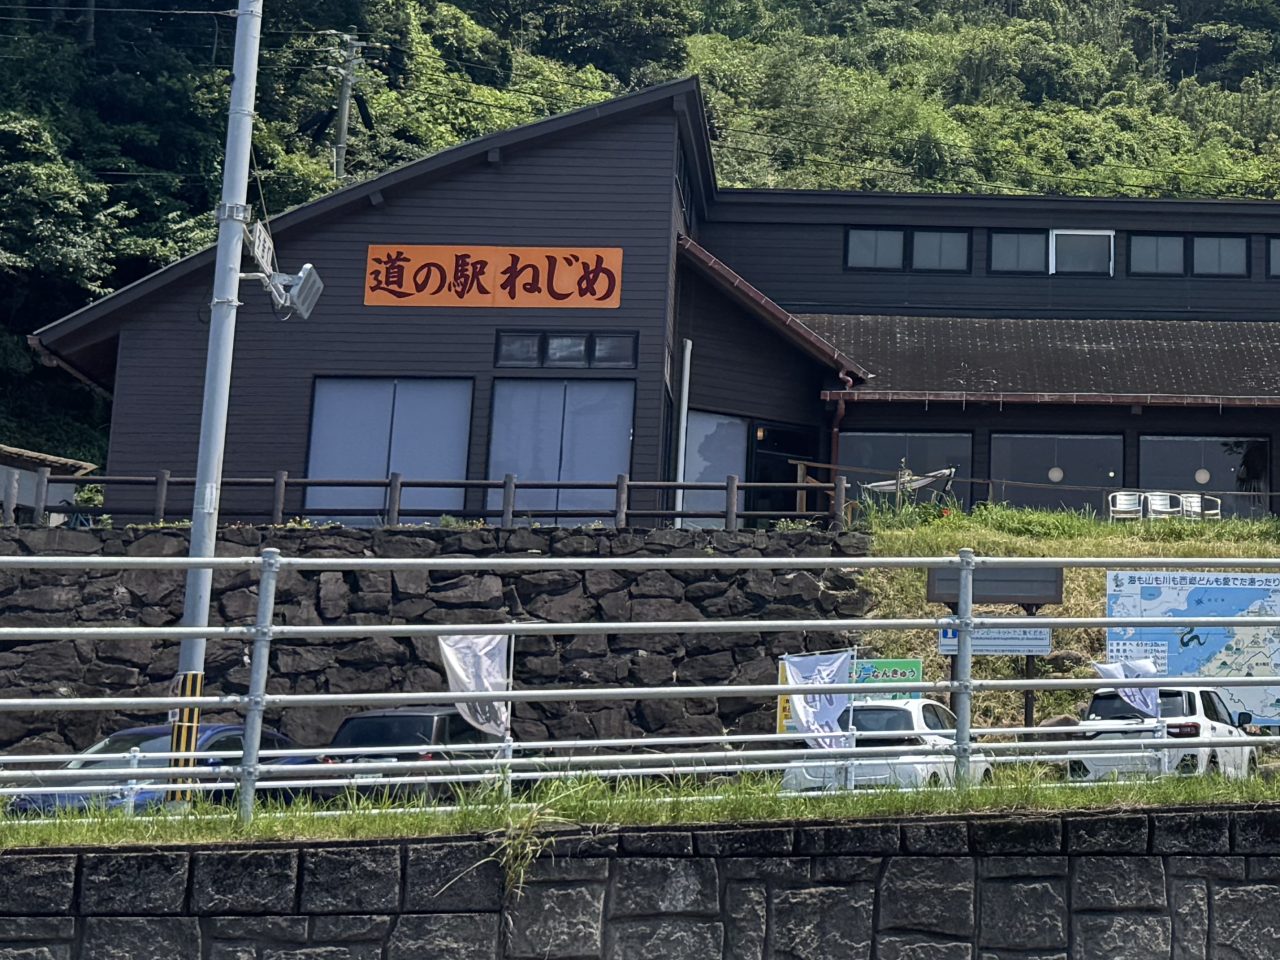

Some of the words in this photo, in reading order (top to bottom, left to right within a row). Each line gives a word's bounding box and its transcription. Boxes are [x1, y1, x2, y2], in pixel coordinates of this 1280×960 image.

[369, 251, 617, 301] 道の駅ねじめ
